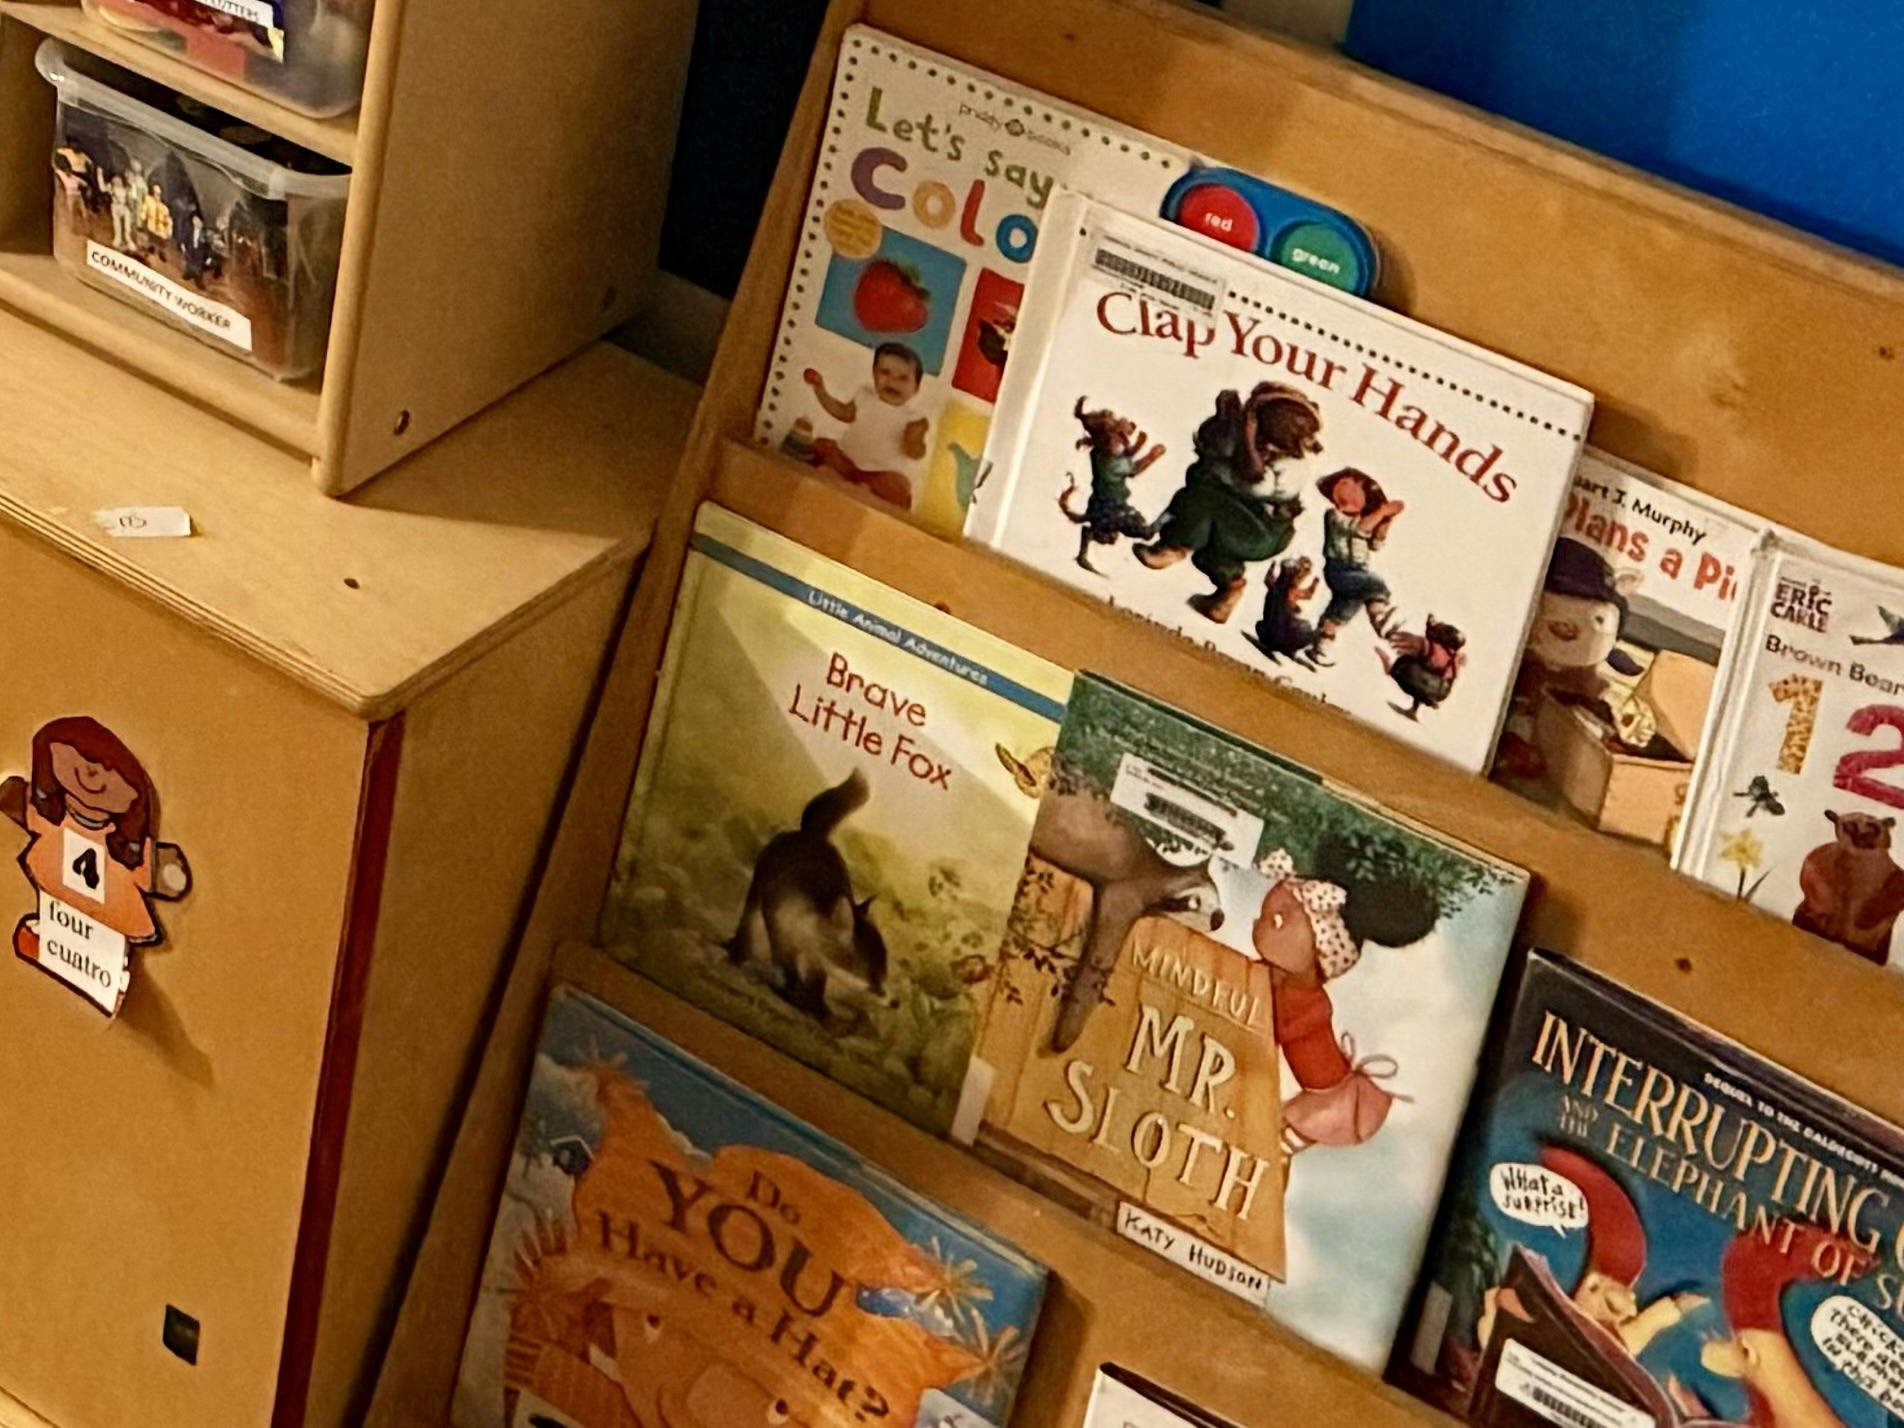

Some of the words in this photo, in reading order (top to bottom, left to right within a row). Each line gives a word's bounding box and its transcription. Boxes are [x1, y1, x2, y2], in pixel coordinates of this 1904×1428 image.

[865, 85, 966, 162] Let's
[984, 149, 1054, 211] say
[851, 147, 1041, 266] Colo
[1204, 211, 1234, 233] red
[91, 249, 171, 300] COMMUNITY
[174, 293, 231, 329] WORKER
[1290, 246, 1343, 275] green
[1096, 290, 1216, 359] Clap
[1223, 310, 1347, 391] Your
[1349, 363, 1518, 505] Hands
[1631, 498, 1708, 546] Murphy
[1659, 547, 1684, 581] a
[1774, 580, 1833, 609] ERIC
[808, 589, 849, 619] Little
[851, 613, 901, 644] Animal
[903, 638, 989, 685] Adventures
[1765, 633, 1843, 678] Brown
[1769, 600, 1831, 634] CARLE
[826, 651, 926, 727] Brave
[789, 683, 883, 756] Little
[891, 734, 952, 791] Fox
[1768, 672, 1824, 776] 1
[1833, 703, 1904, 811] 2
[72, 847, 100, 890] 4
[49, 899, 94, 941] four
[46, 937, 112, 989] cuatro
[1131, 941, 1262, 1027] MINDFUL
[1124, 1004, 1236, 1119] MR.
[1703, 1071, 1753, 1107] SEQUEL
[1757, 1100, 1776, 1118] TO
[1776, 1110, 1801, 1133] THE
[1043, 1060, 1271, 1221] SLOTH
[1531, 1009, 1890, 1255] INTERRUPTING
[746, 1168, 801, 1225] Do
[1606, 1122, 1795, 1254] ELEPHANT
[1812, 1233, 1864, 1284] OF
[648, 1159, 846, 1319] YOU
[1123, 1207, 1176, 1251] KATY
[1188, 1243, 1263, 1290] HUDSON
[598, 1208, 717, 1295] Have
[731, 1297, 757, 1325] a
[768, 1309, 891, 1423] Hat?
